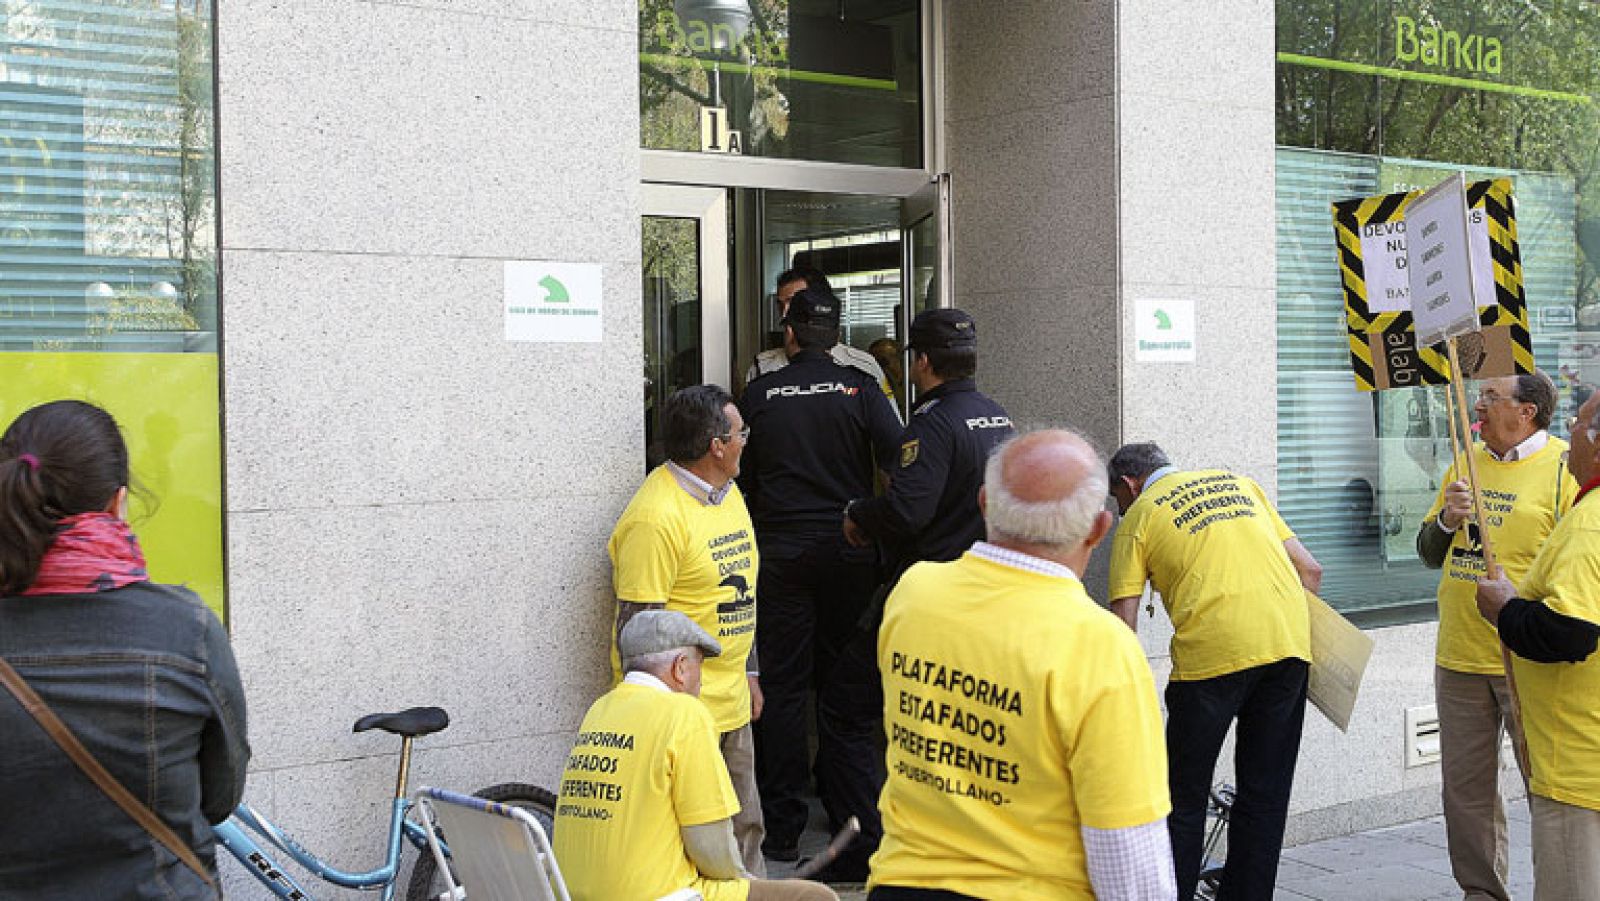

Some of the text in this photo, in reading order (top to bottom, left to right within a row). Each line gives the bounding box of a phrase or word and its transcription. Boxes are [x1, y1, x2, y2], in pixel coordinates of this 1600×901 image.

[1395, 16, 1502, 74] Bankia
[766, 383, 844, 401] POLICIA
[1154, 473, 1236, 506] PLATAFORMA
[1170, 483, 1240, 512] ESTAFADOS
[1173, 494, 1255, 529] PREFERENTES
[891, 651, 1023, 717] PLATAFORMA
[899, 689, 1008, 746] ESTAFADOS
[891, 721, 1021, 785] PREFERENTES
